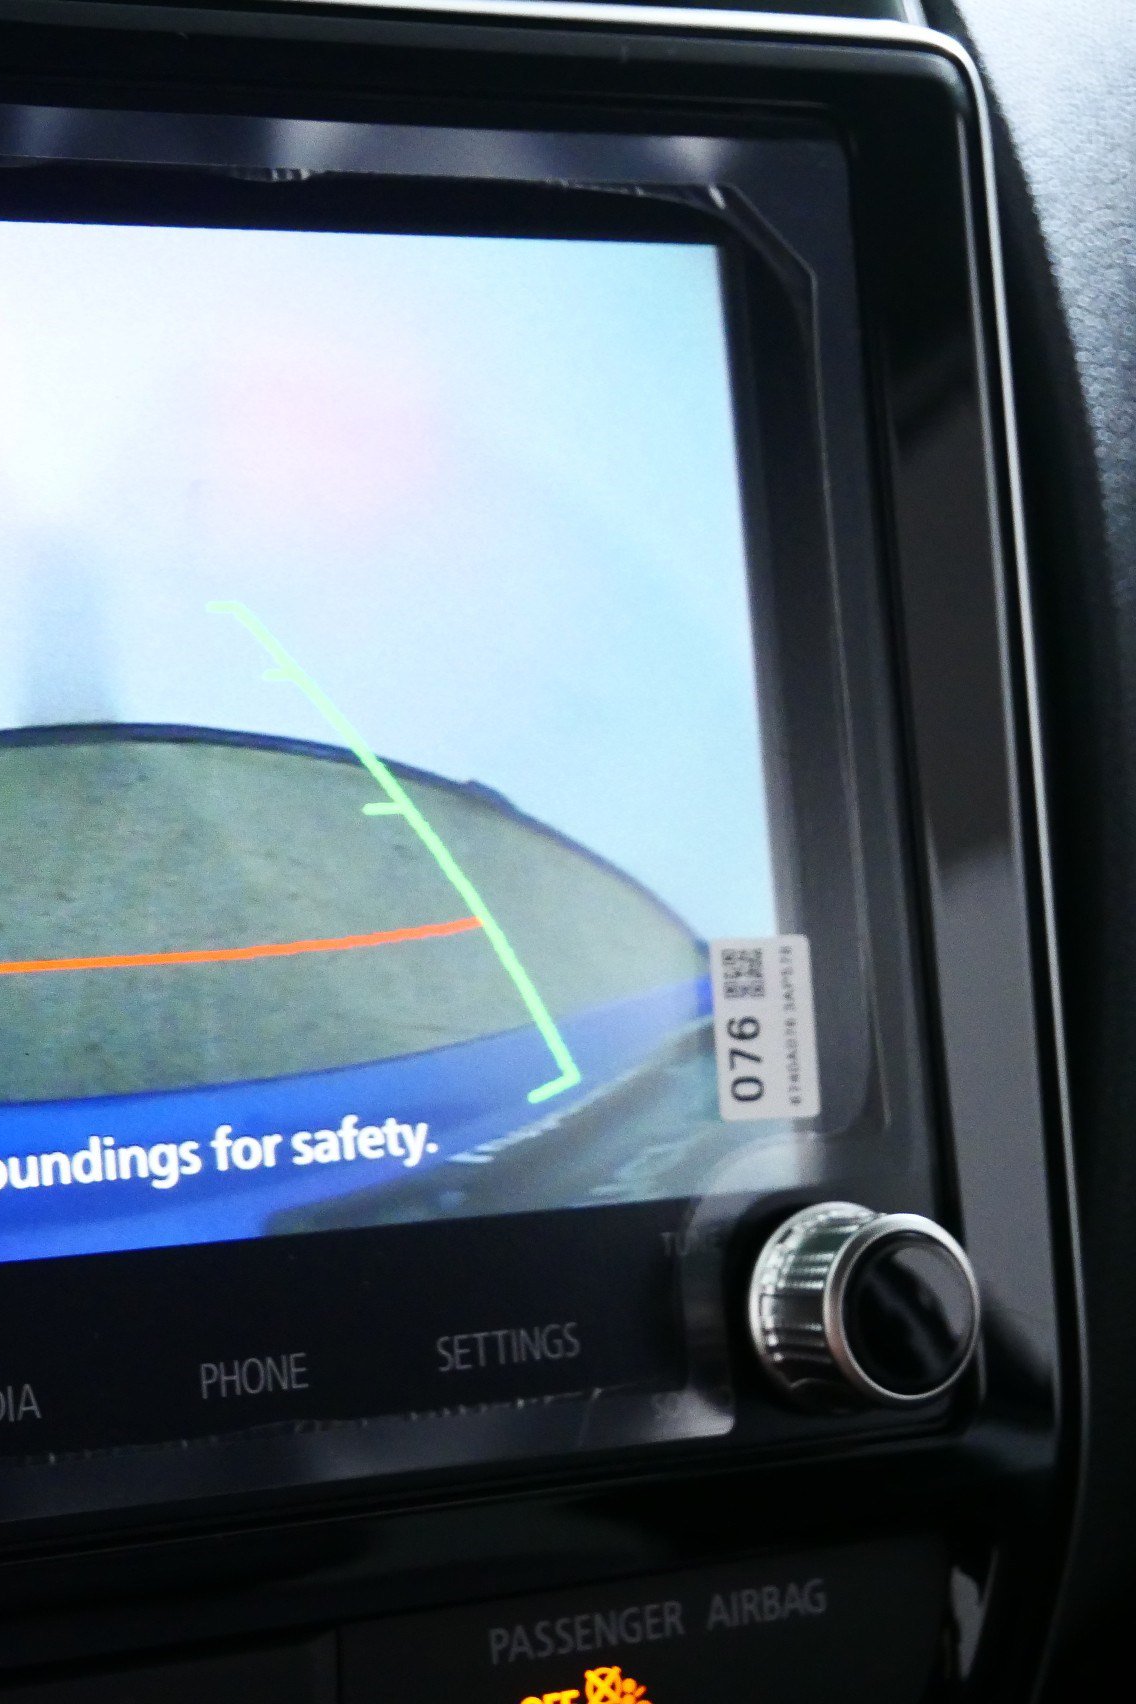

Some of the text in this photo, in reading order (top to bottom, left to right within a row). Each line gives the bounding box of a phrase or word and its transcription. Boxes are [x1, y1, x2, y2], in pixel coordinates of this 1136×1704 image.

[727, 1015, 765, 1102] 076
[211, 1124, 282, 1172] for
[291, 1116, 439, 1167] safety.
[437, 1321, 581, 1373] SETTINGS
[200, 1352, 310, 1400] PHONE
[488, 1578, 828, 1665] PASSENGER AIRBAG
